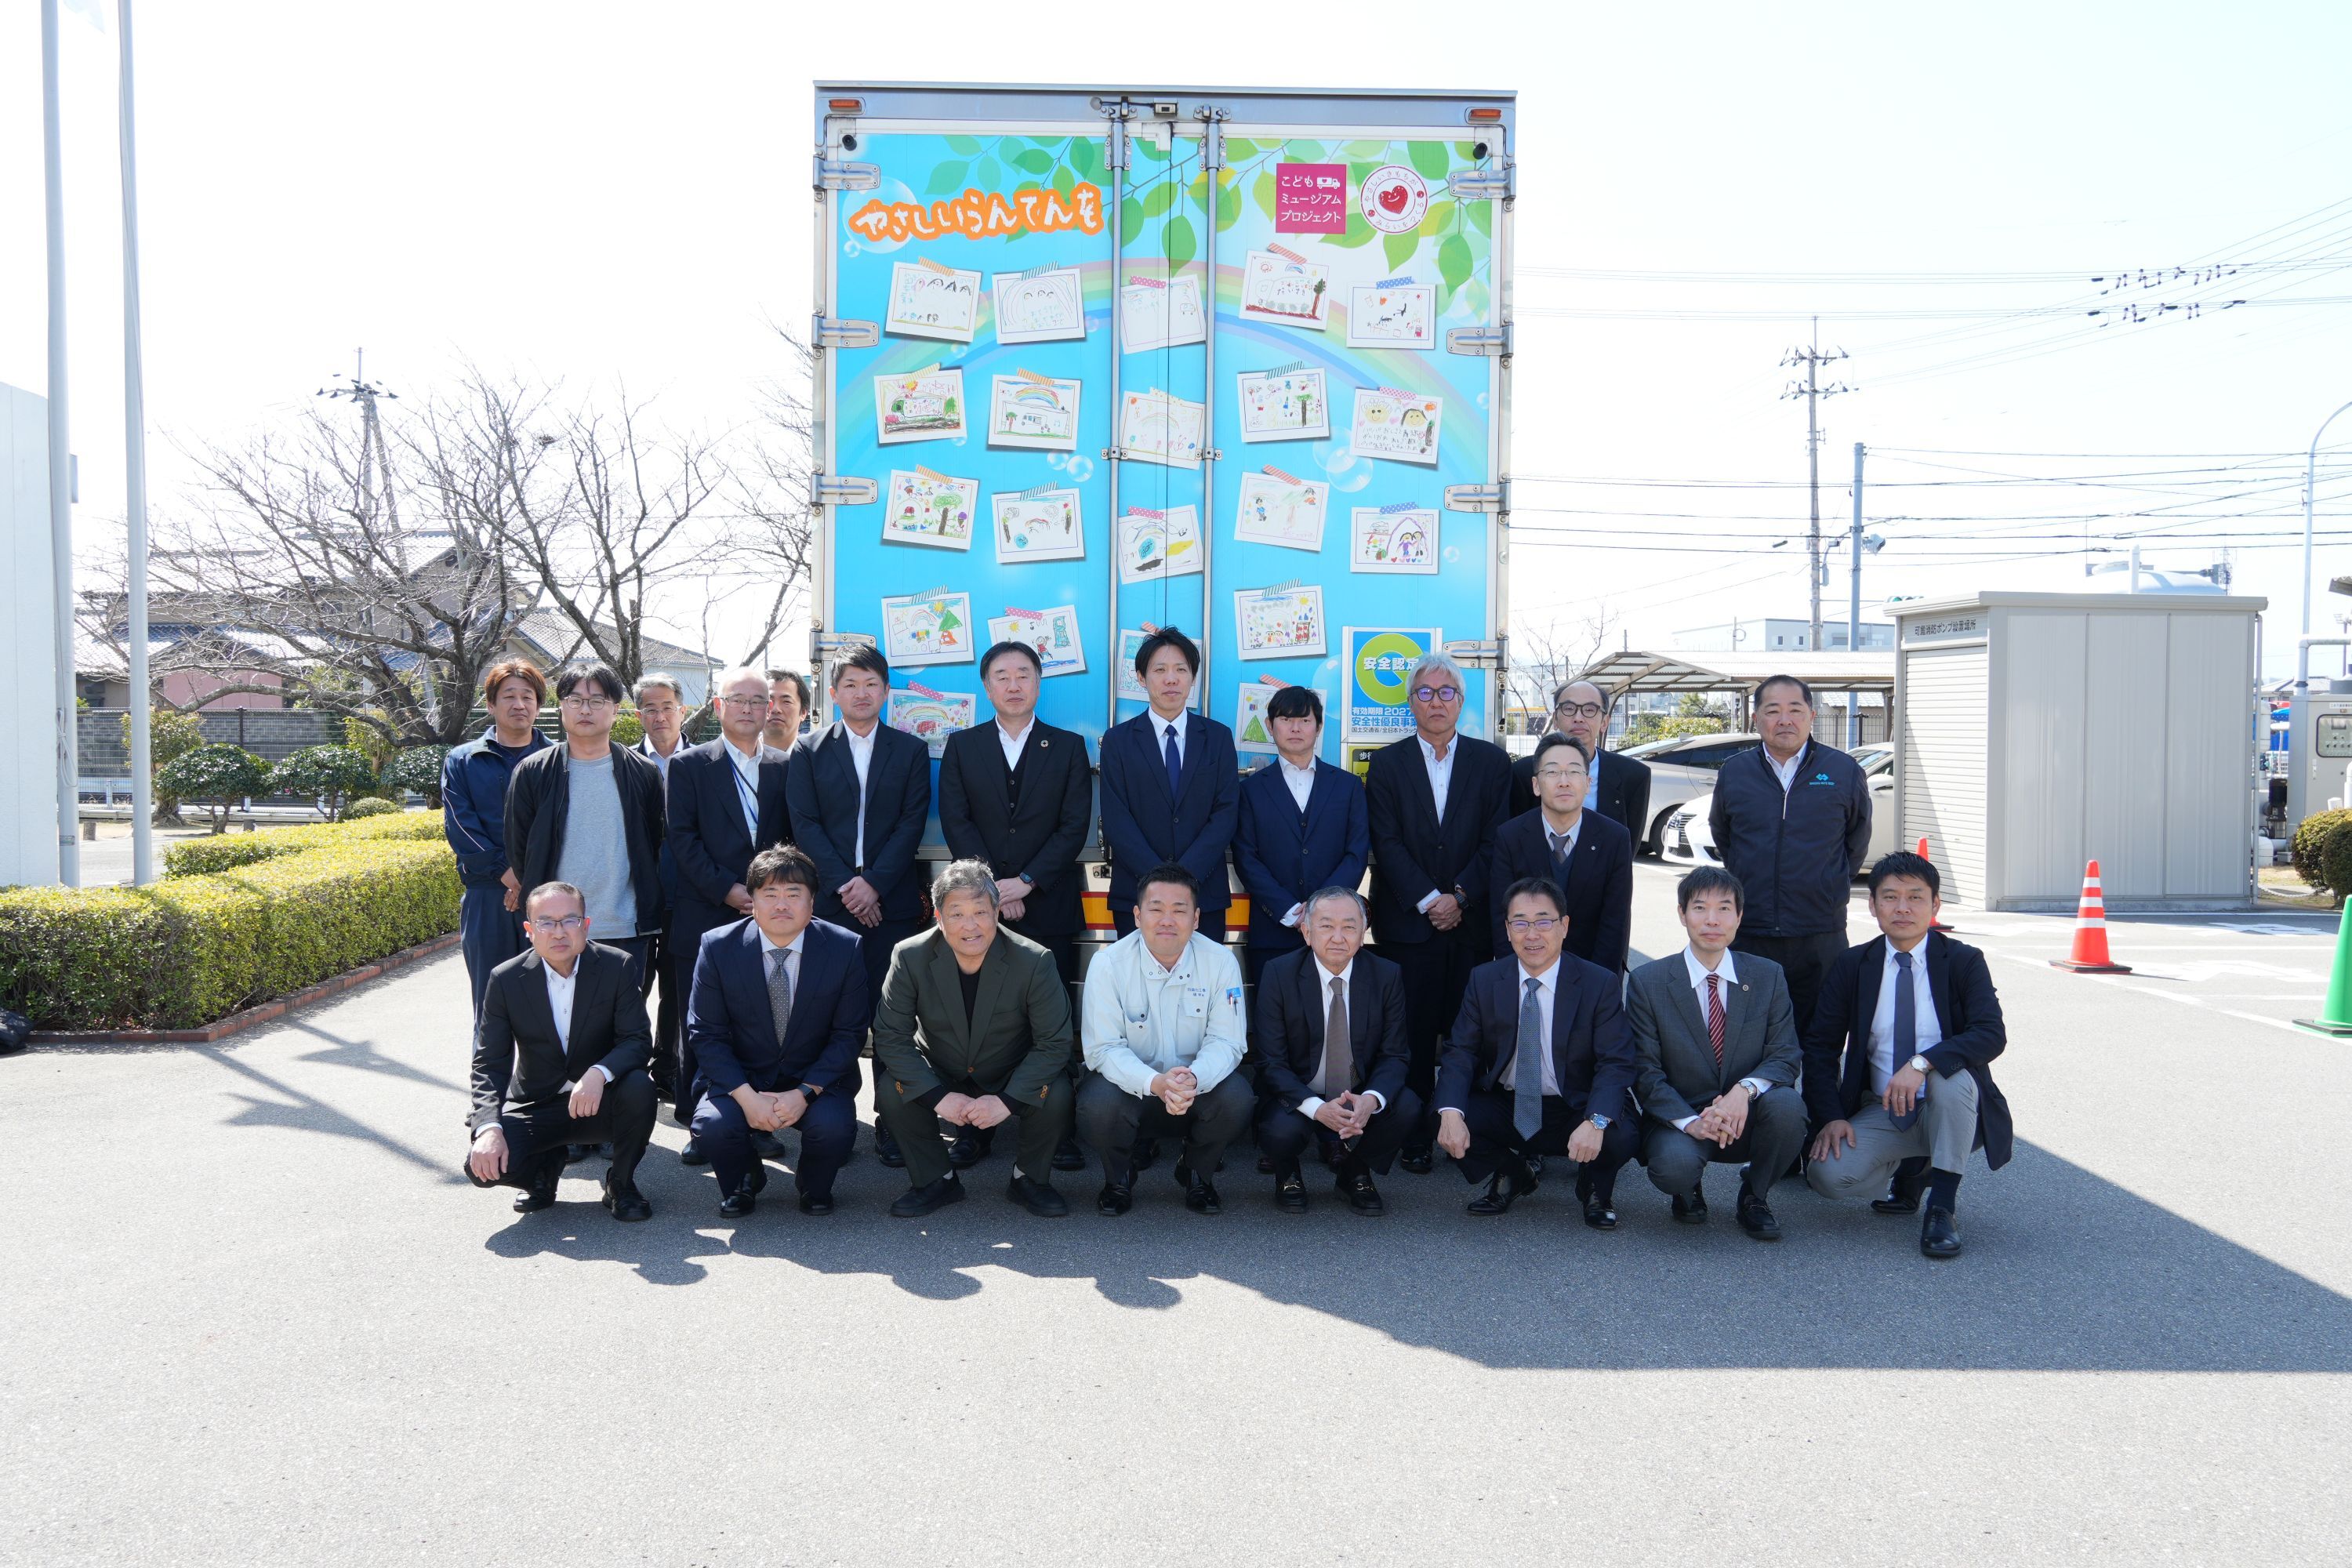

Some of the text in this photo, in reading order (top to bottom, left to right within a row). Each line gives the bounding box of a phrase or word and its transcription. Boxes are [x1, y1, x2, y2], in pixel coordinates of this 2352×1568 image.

[1281, 175, 1313, 187] こども
[1281, 193, 1341, 205] ミュージアム
[853, 187, 1100, 237] やさしいうんてんを
[1281, 212, 1341, 223] プロジェクト
